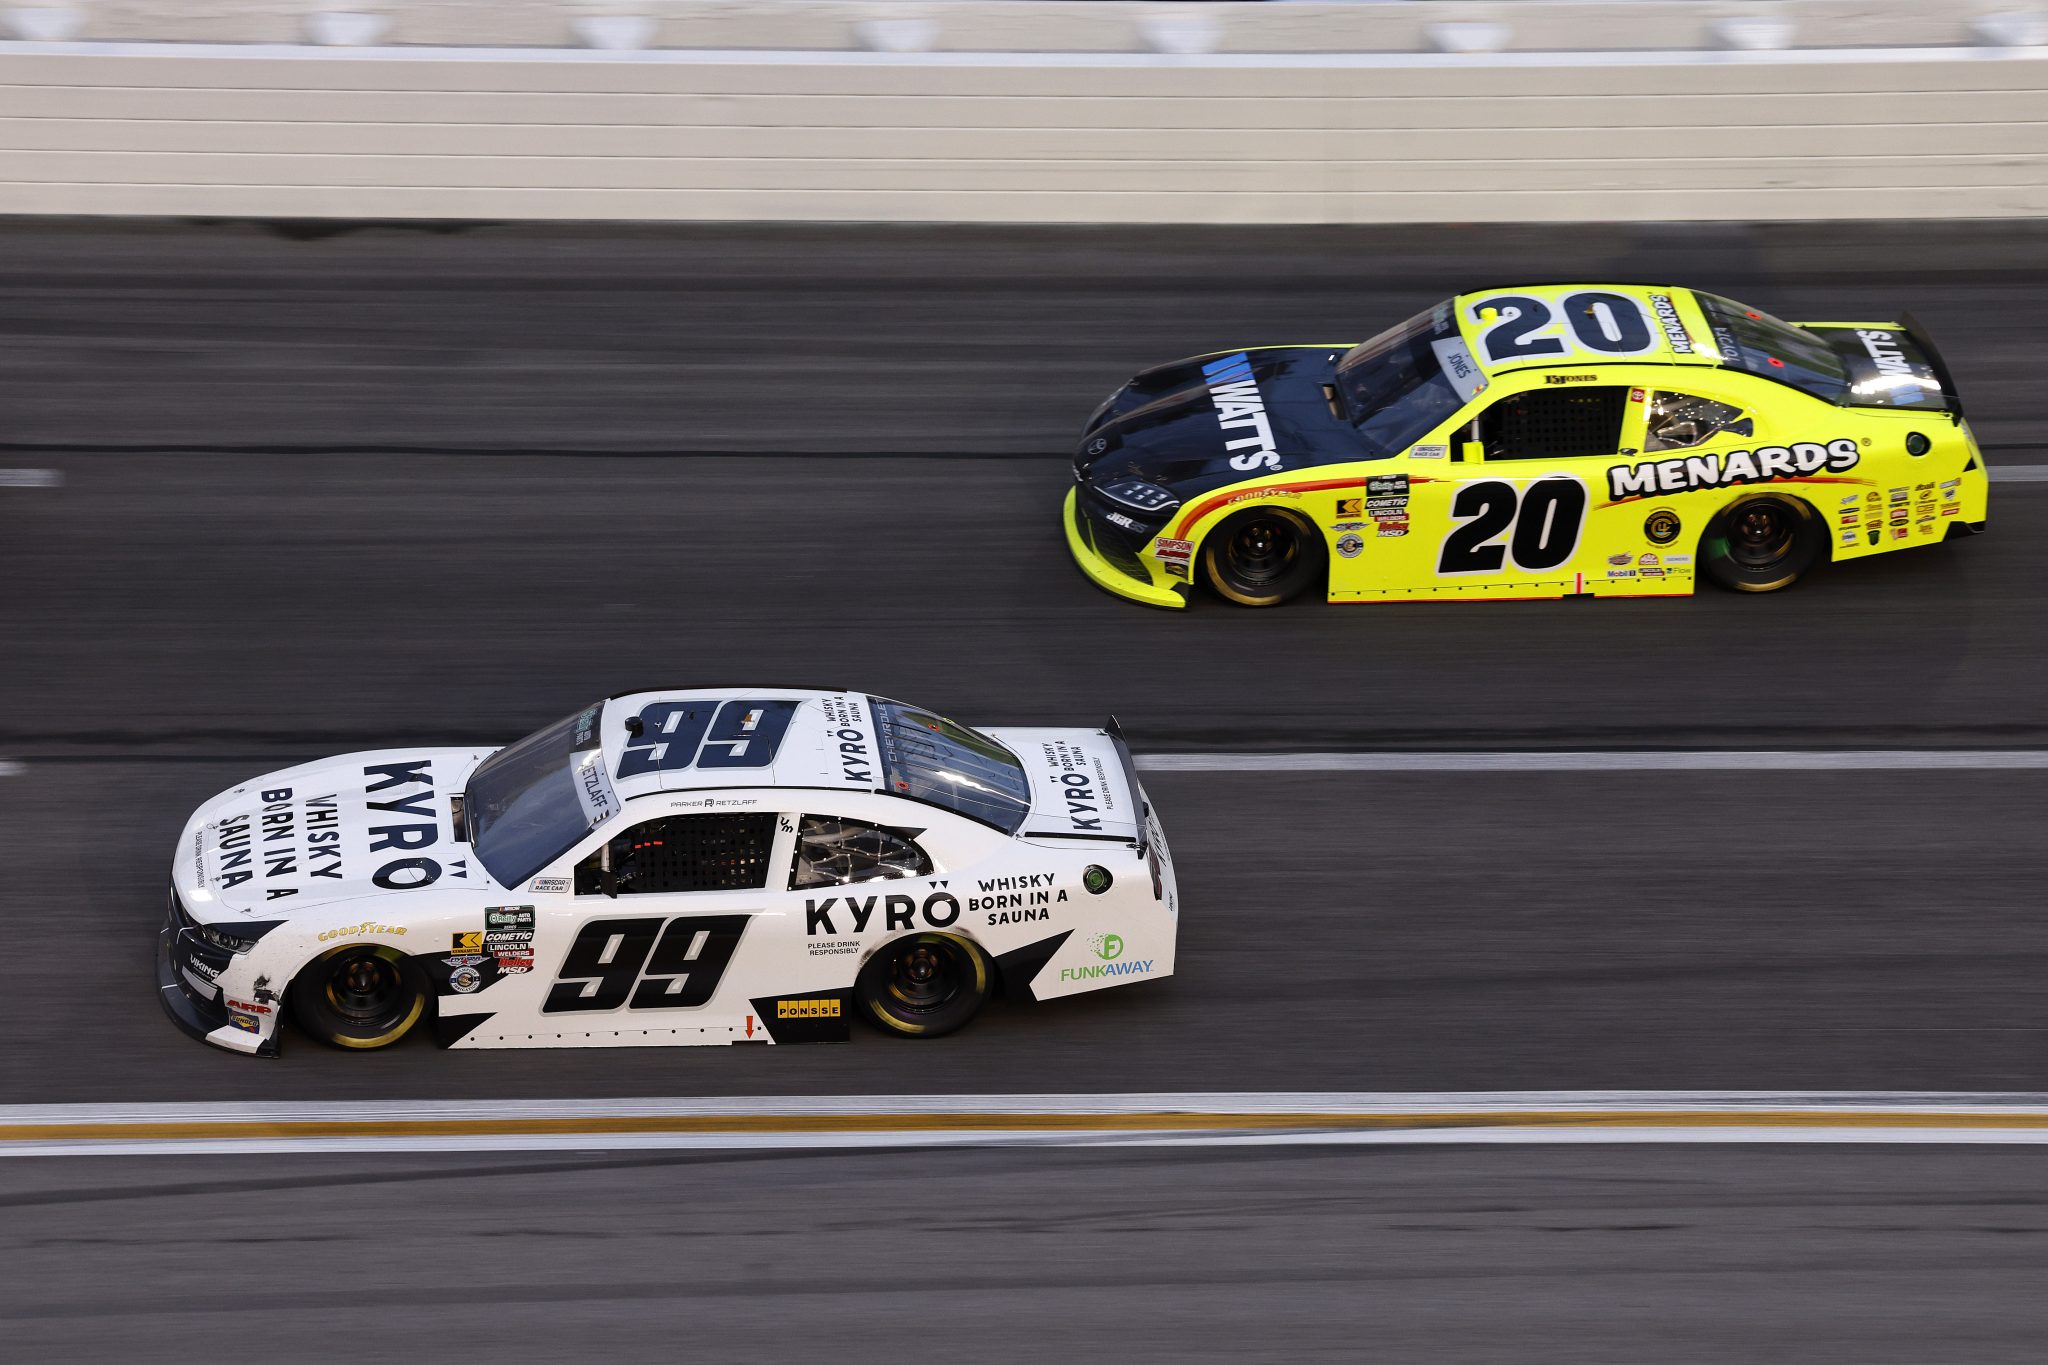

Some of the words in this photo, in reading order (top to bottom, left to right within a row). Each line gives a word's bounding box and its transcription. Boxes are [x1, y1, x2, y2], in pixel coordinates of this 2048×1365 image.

[1472, 291, 1651, 363] 20
[1649, 294, 1695, 355] MENARDS
[1447, 352, 1472, 379] JONES
[1208, 379, 1281, 471] WATTS
[1608, 438, 1860, 501] MENARDS
[1366, 498, 1408, 508] COMETIC
[1370, 509, 1403, 517] LINCOLN
[1436, 475, 1586, 574] 20
[1156, 538, 1193, 552] SIMPSON
[821, 698, 837, 722] WHISKY
[837, 709, 851, 727] BORN
[848, 702, 862, 722] SAUNA
[614, 699, 803, 782] 99
[1042, 742, 1060, 768] WHISKY
[1060, 754, 1075, 772] BORN
[1070, 746, 1087, 766] SAUNA
[260, 787, 295, 842] BORN
[305, 793, 343, 879] WHISKY
[218, 814, 254, 890] SAUNA
[263, 847, 298, 878] IN
[977, 872, 1056, 893] WHISKY
[266, 888, 299, 901] A
[968, 892, 1022, 912] BORN
[1029, 890, 1049, 907] IN
[1056, 888, 1069, 903] A
[987, 907, 1050, 926] SAUNA
[317, 921, 408, 942] GOODYEAR
[485, 931, 533, 942] COMETIC
[489, 942, 527, 951] LINCOLN
[497, 949, 530, 957] WELDERS
[807, 941, 836, 950] PLEASE
[837, 940, 861, 948] DRINK
[809, 947, 859, 956] RESPONSIBLY
[190, 953, 220, 978] VIKING
[496, 965, 529, 975] MSD
[541, 913, 753, 1016] 99
[1060, 959, 1154, 982] FUNKAWAY
[226, 999, 272, 1014] ARP
[779, 1006, 839, 1016] PONSSE
[230, 1014, 259, 1027] SUNOCO
